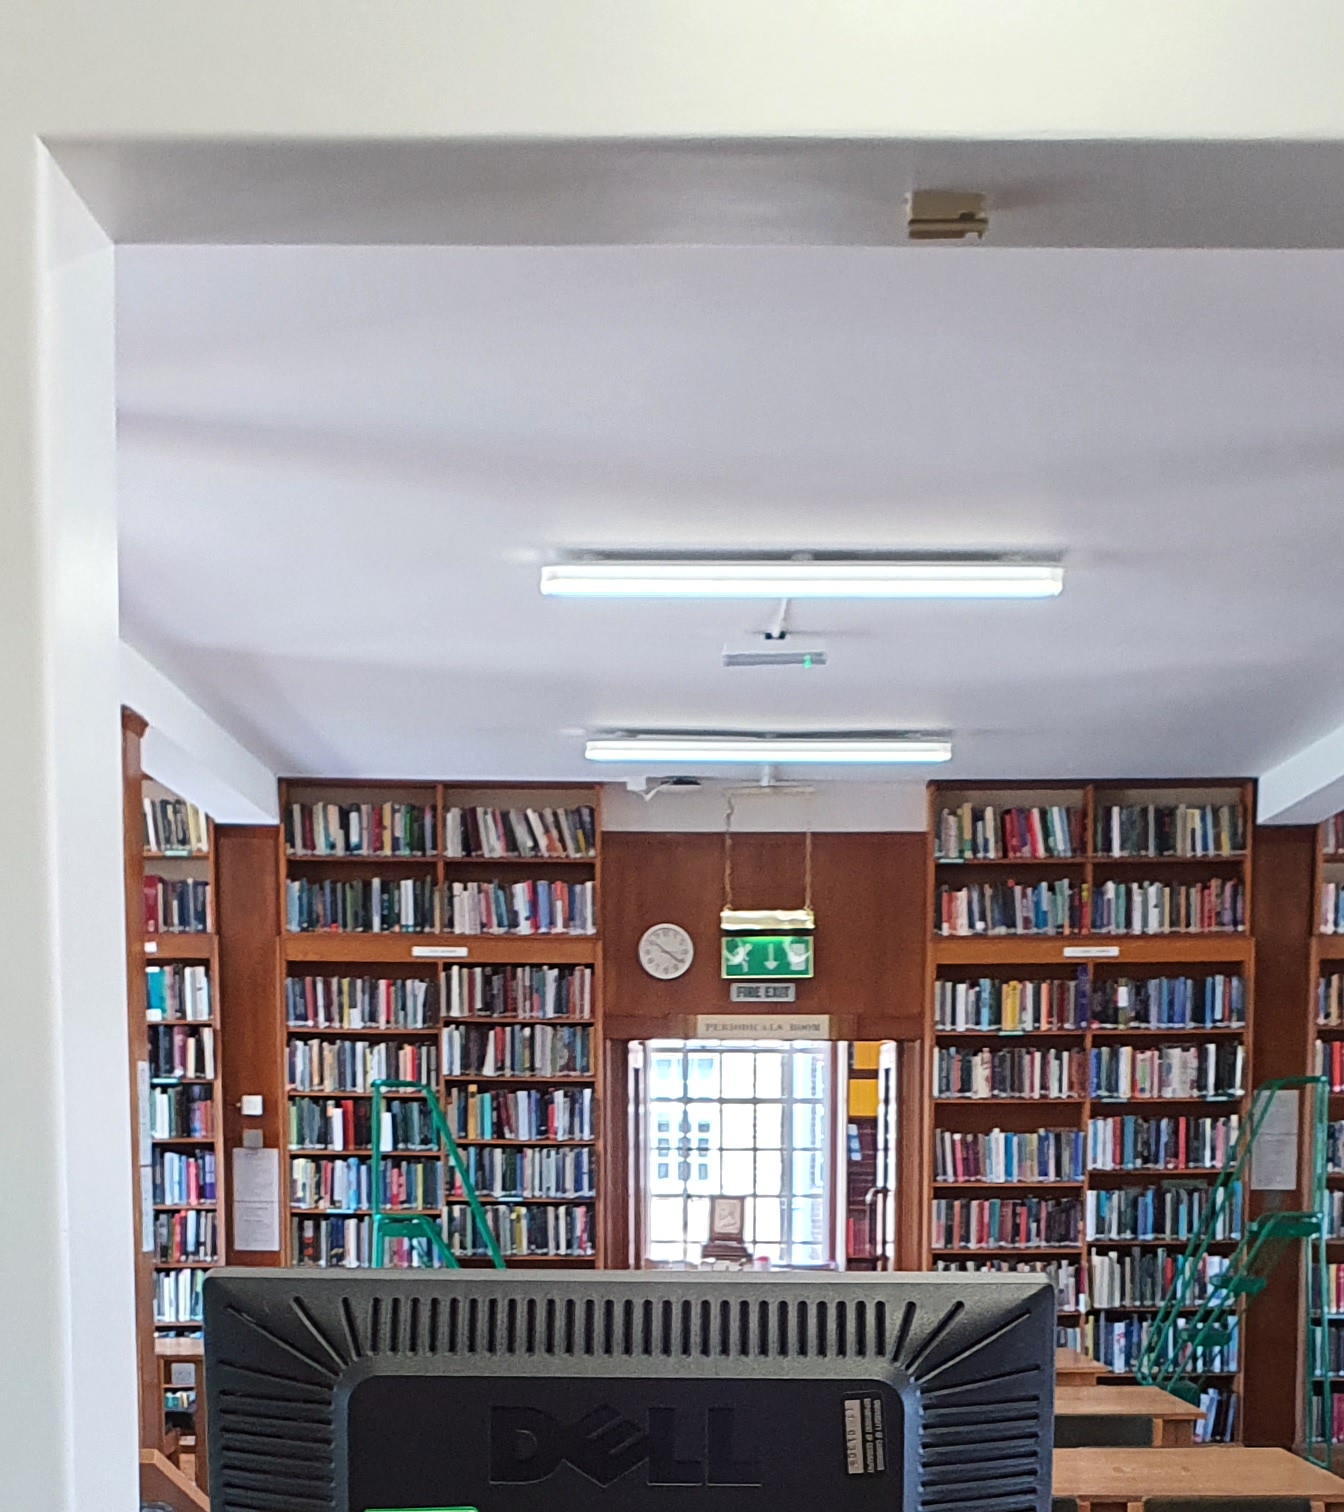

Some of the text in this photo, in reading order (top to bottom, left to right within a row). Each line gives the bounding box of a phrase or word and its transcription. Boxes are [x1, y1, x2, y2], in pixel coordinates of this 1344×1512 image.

[736, 986, 790, 998] FIRE EXIT
[489, 1403, 763, 1488] DELL
